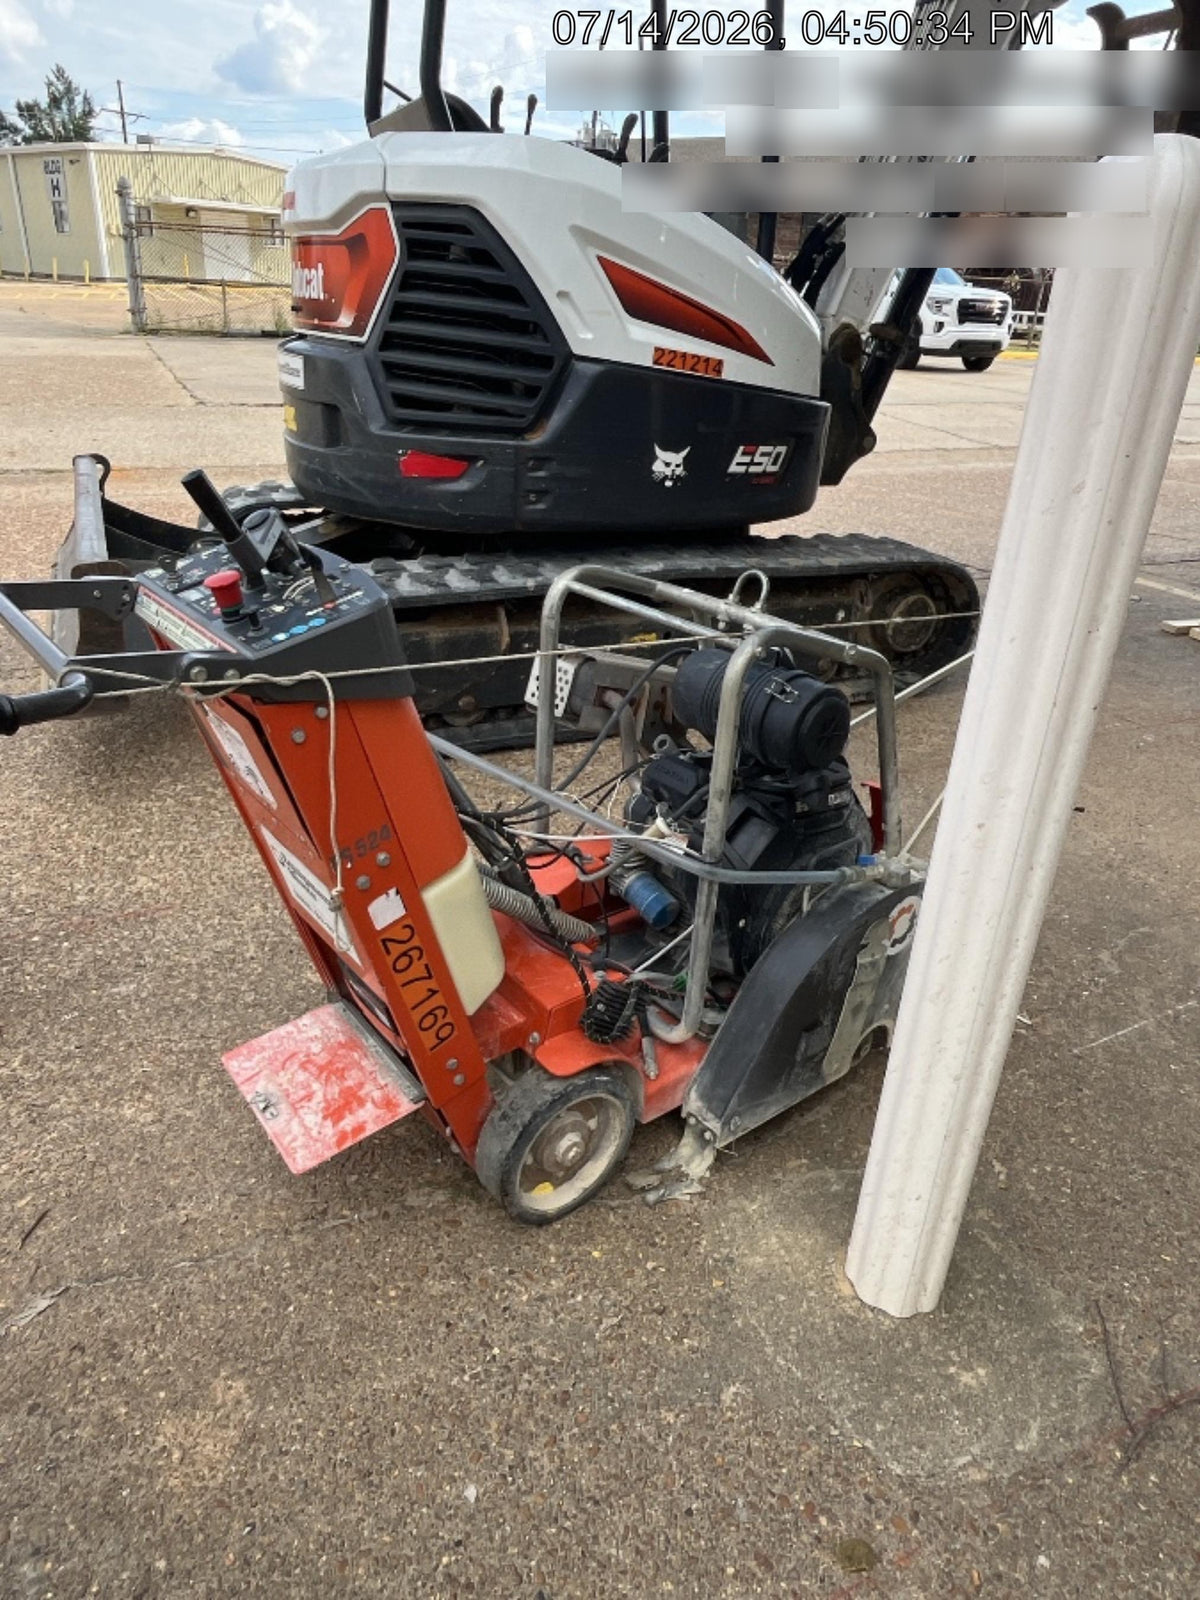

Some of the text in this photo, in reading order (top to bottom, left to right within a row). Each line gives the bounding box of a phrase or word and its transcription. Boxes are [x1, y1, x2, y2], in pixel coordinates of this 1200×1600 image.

[654, 348, 723, 376] 221214
[726, 445, 788, 473] E50
[380, 924, 456, 1052] 267169
